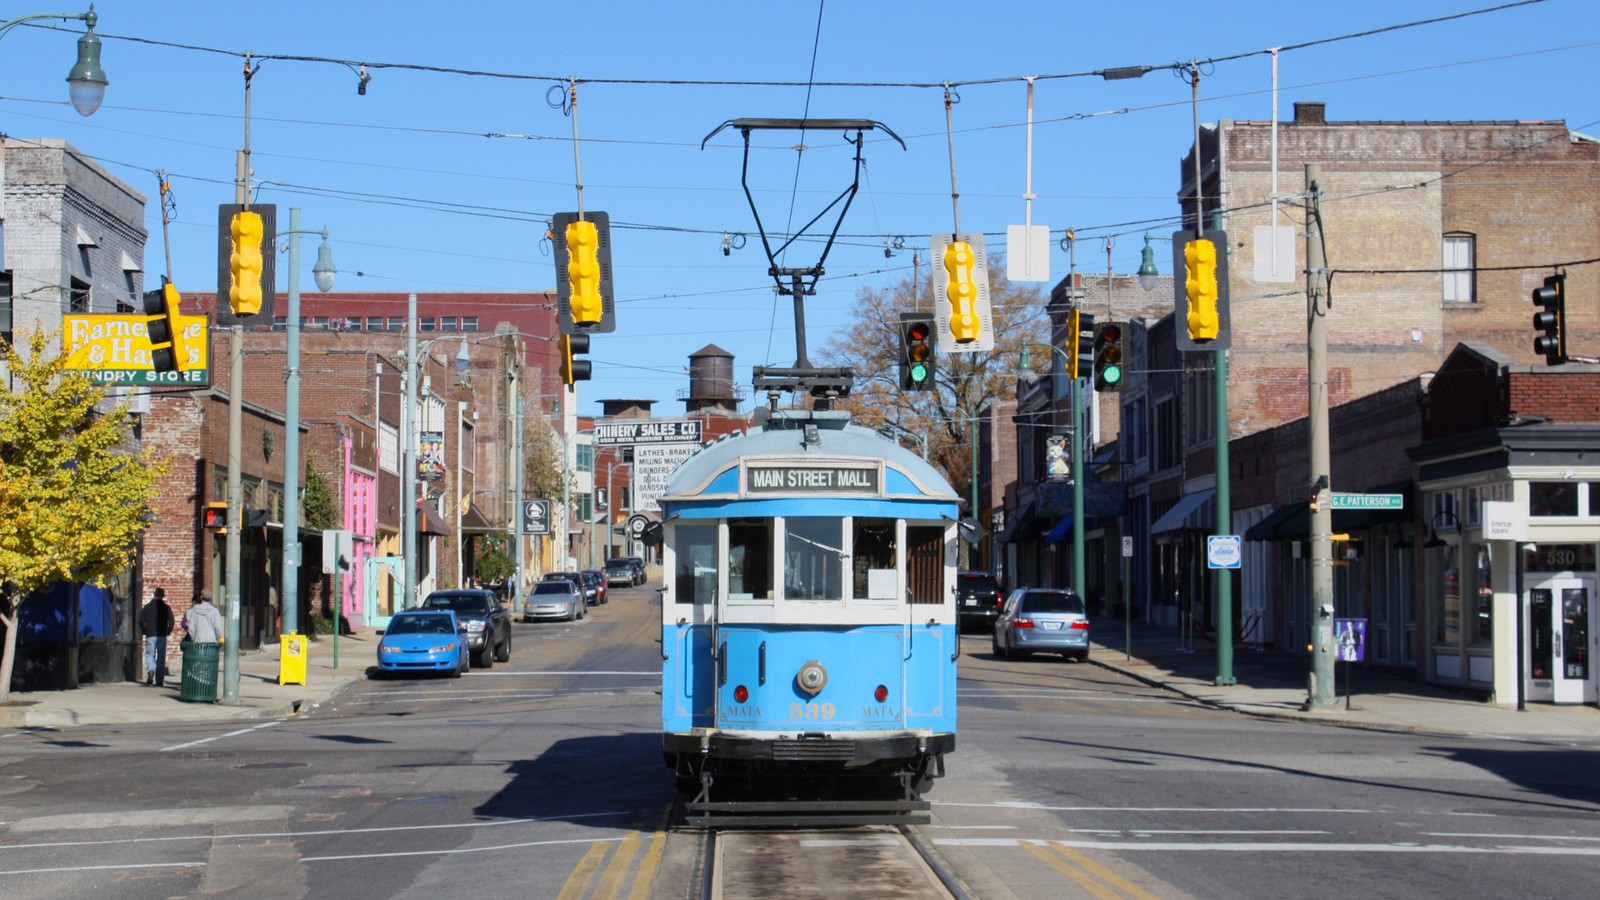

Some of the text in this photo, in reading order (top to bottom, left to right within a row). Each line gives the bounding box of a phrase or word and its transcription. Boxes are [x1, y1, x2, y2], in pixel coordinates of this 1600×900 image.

[88, 344, 106, 364] &
[145, 370, 202, 382] STORE
[641, 423, 676, 436] SALES
[681, 422, 699, 435] CO.
[754, 470, 871, 487] MAIN STREET MALL
[1347, 496, 1390, 506] PATTERSON
[1547, 550, 1575, 565] 530
[728, 705, 762, 718] MATA
[789, 702, 836, 720] 539
[861, 706, 894, 717] MATA
